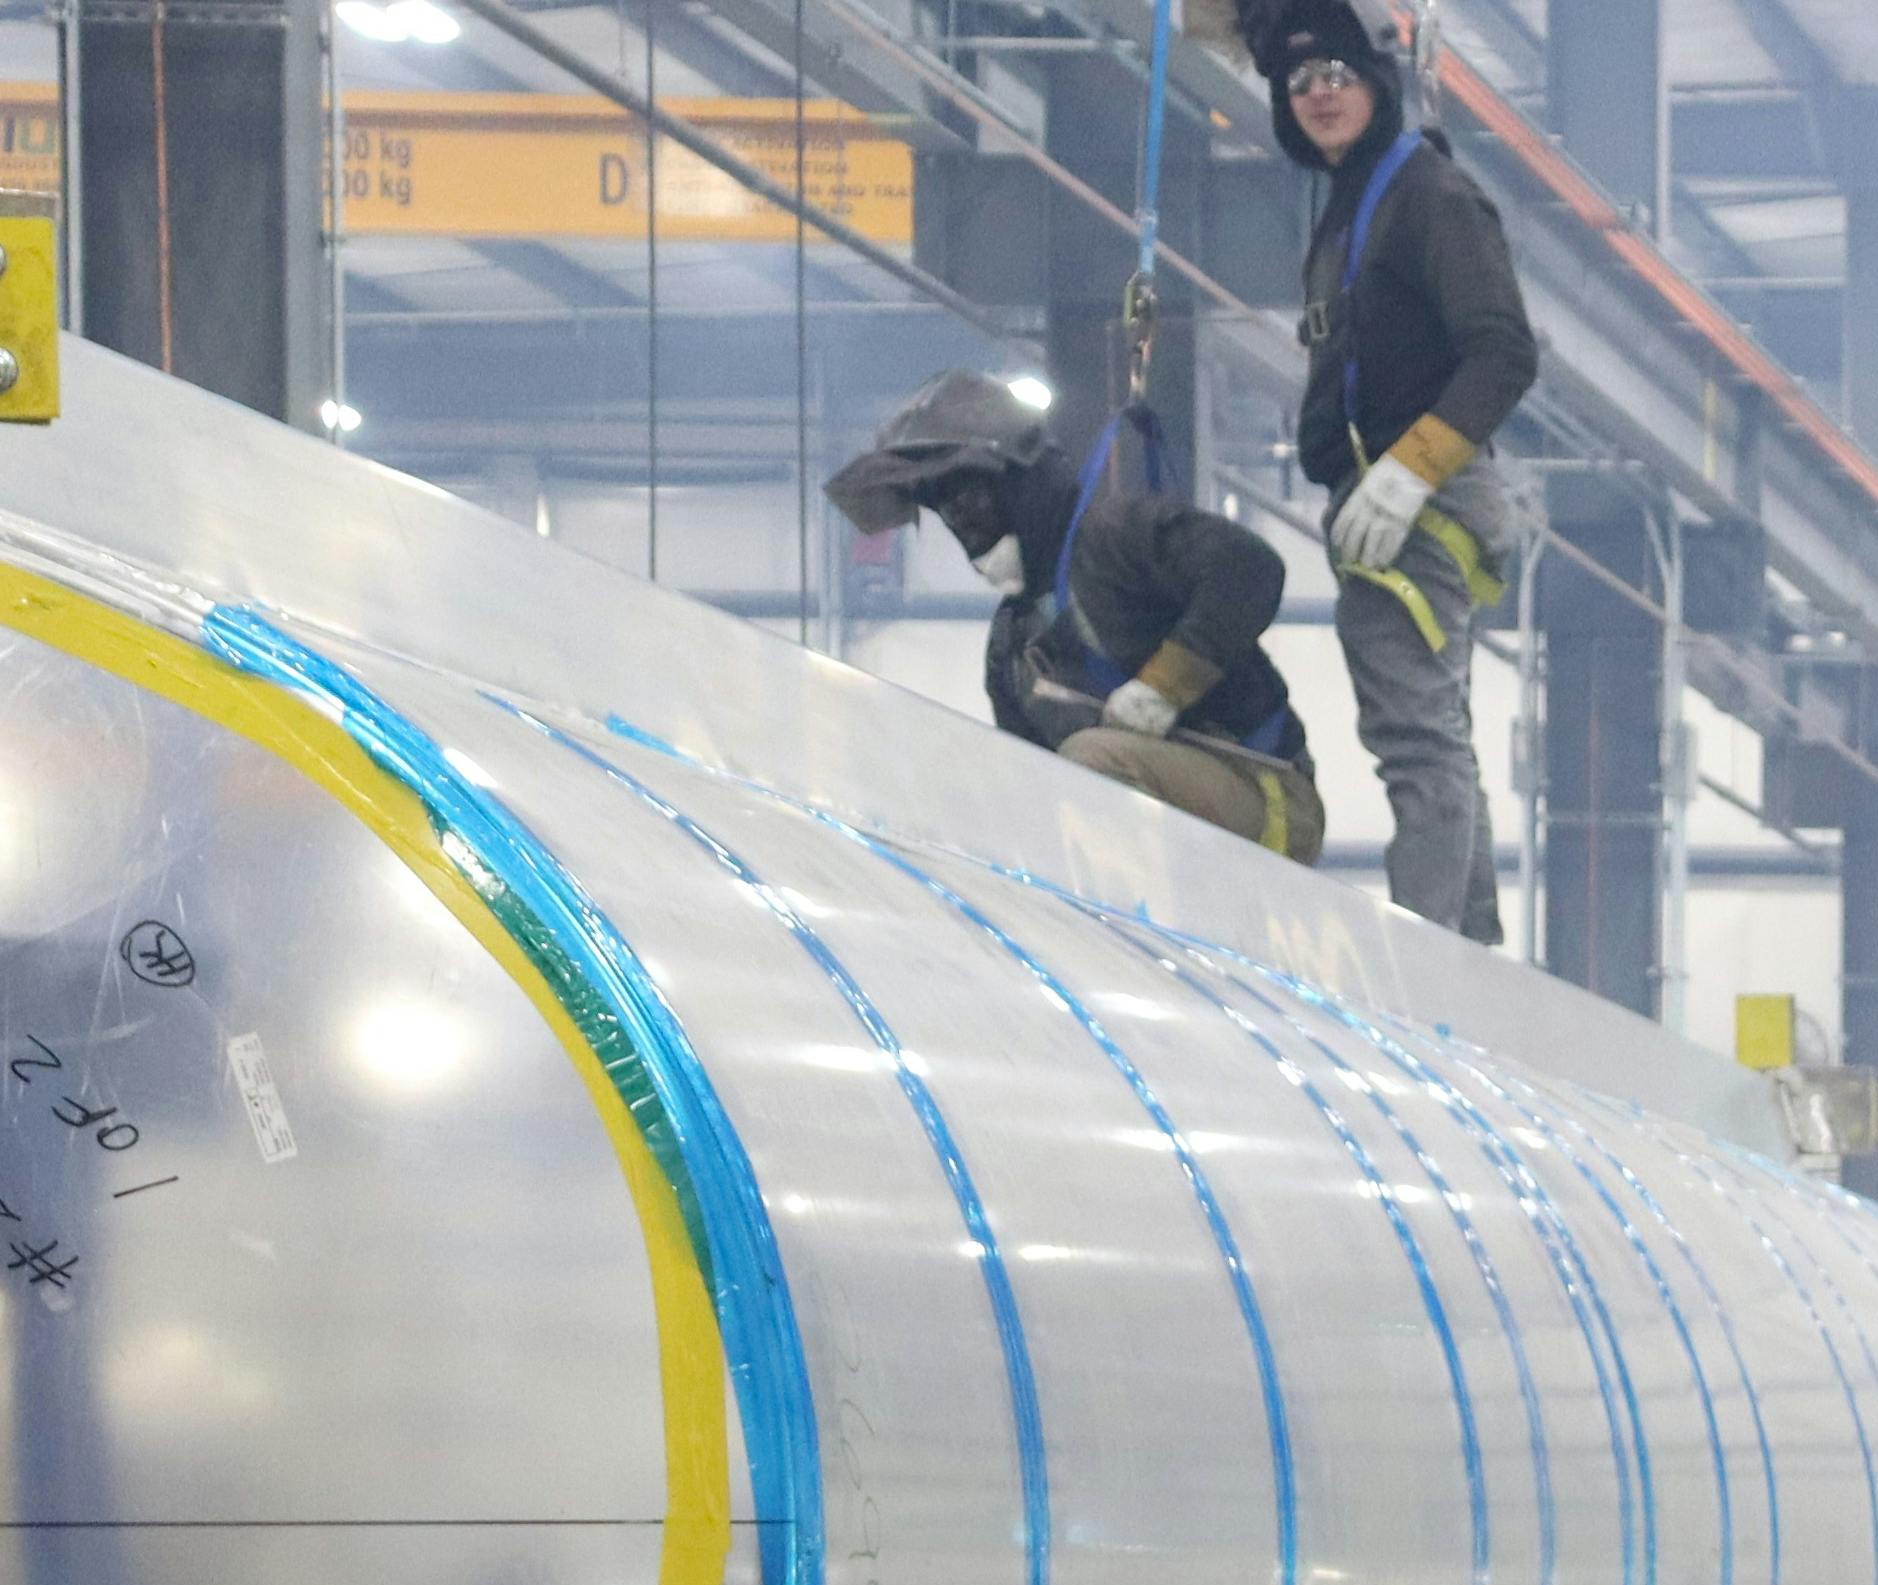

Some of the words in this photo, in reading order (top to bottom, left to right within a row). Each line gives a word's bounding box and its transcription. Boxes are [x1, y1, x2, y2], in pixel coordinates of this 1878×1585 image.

[379, 130, 412, 168] kg
[379, 169, 412, 207] kg
[598, 153, 628, 206] D
